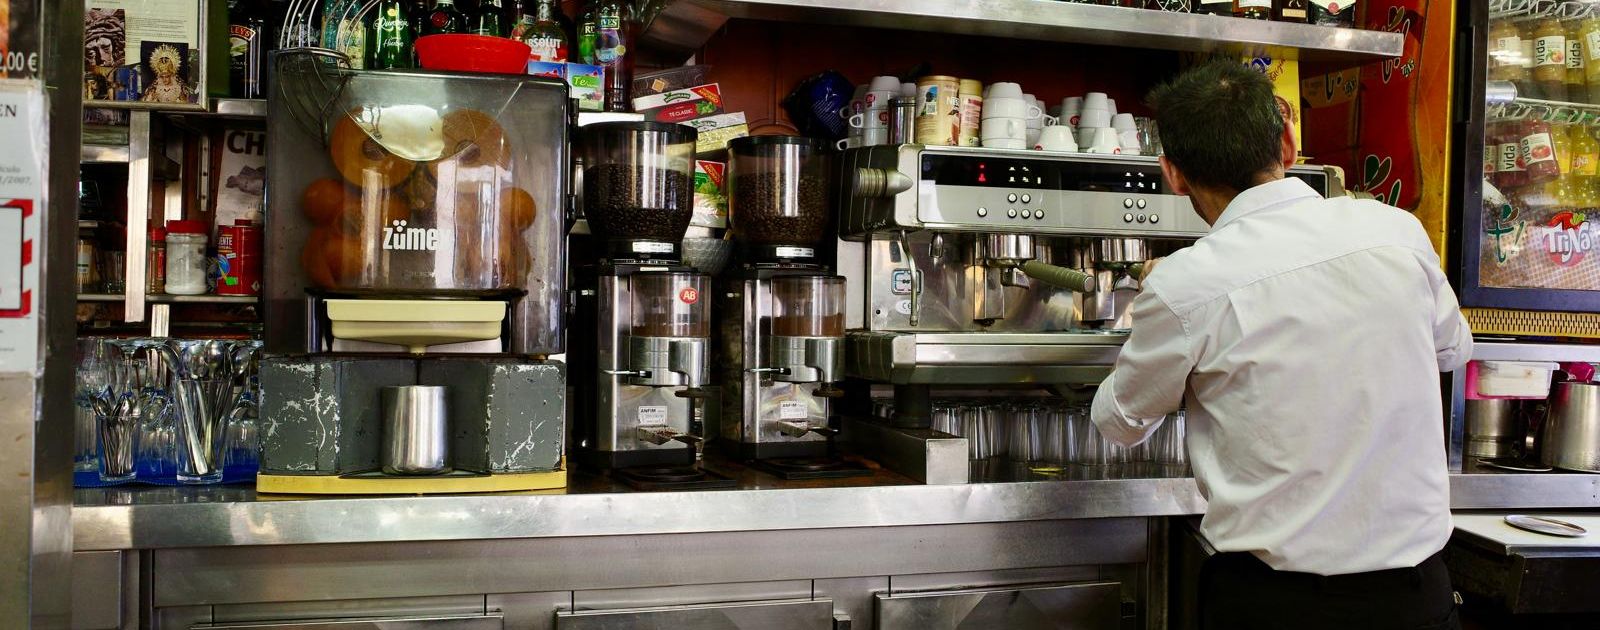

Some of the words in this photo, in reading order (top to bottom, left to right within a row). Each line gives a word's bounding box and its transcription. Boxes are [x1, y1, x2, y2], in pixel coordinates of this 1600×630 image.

[28, 52, 37, 71] €
[1535, 39, 1545, 64] vida
[1569, 42, 1581, 67] vida
[1504, 145, 1516, 170] vida
